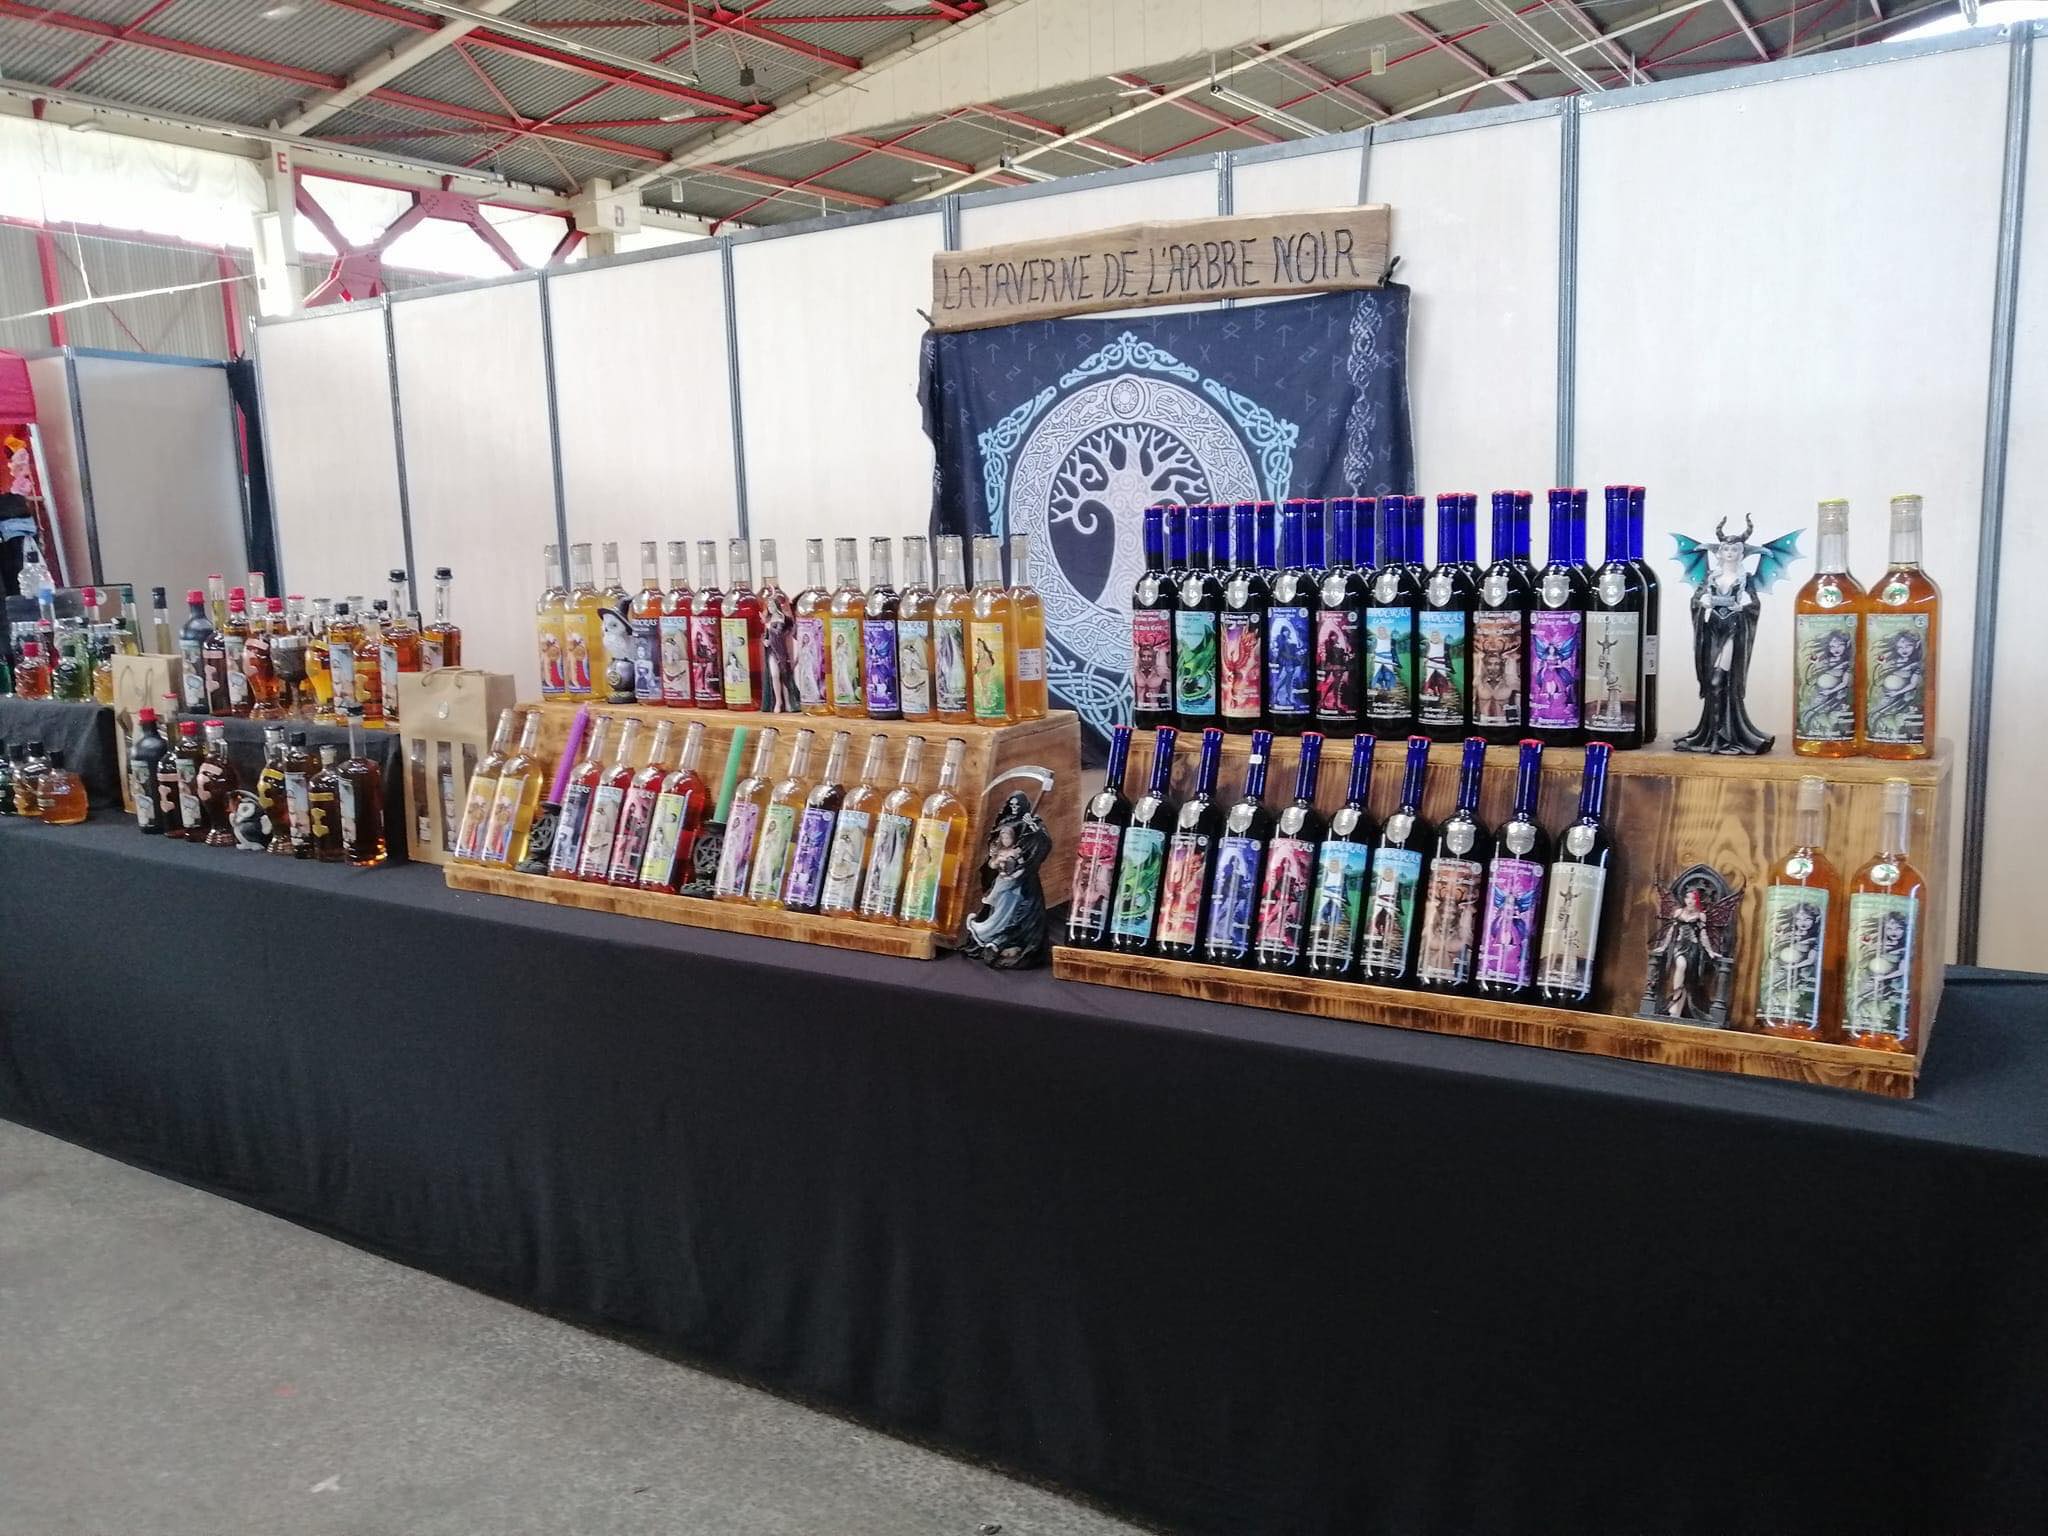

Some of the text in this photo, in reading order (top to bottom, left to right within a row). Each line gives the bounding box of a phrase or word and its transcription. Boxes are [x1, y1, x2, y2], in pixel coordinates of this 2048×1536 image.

[277, 152, 288, 173] E
[942, 228, 1360, 310] LA TAVERNE DE L'ARBRE NOIR
